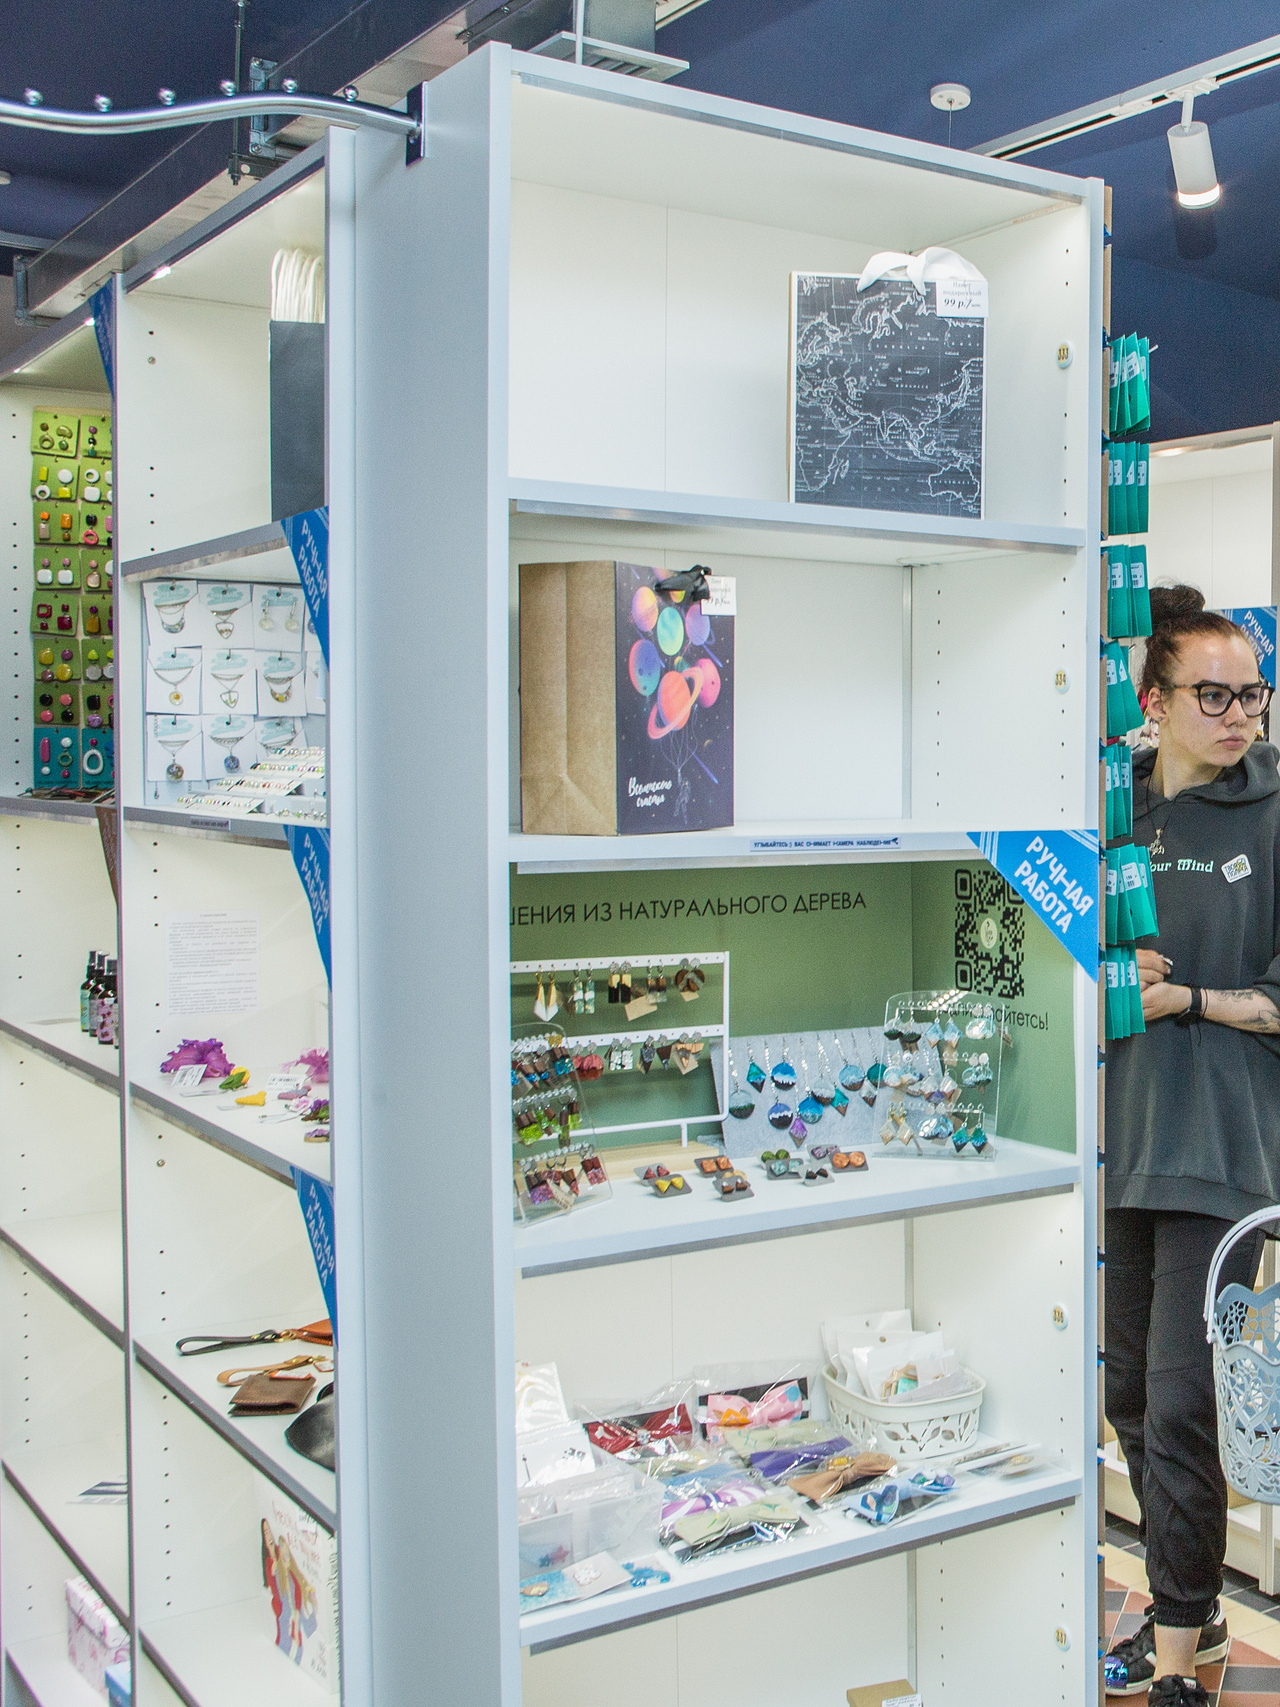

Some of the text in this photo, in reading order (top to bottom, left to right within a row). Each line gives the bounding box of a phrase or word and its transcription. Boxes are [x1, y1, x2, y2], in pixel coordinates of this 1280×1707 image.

[298, 544, 321, 618] РАБОТА
[302, 519, 328, 600] РУЧНАЯ
[1244, 610, 1275, 657] РУЧНАЯ
[301, 856, 323, 935] РАБОТА
[304, 832, 330, 919] РУЧНАЯ
[1014, 860, 1076, 934] РАБОТА
[1026, 835, 1094, 917] РУЧНАЯ
[1149, 861, 1172, 873] our
[1177, 858, 1214, 873] Mind
[584, 901, 612, 922] ИЗ
[620, 894, 788, 921] НАТУРАЛЬНОГО
[793, 892, 867, 914] ДЕРЕВА
[306, 1204, 328, 1288] РАБОТА
[309, 1182, 335, 1275] РУЧНАЯ
